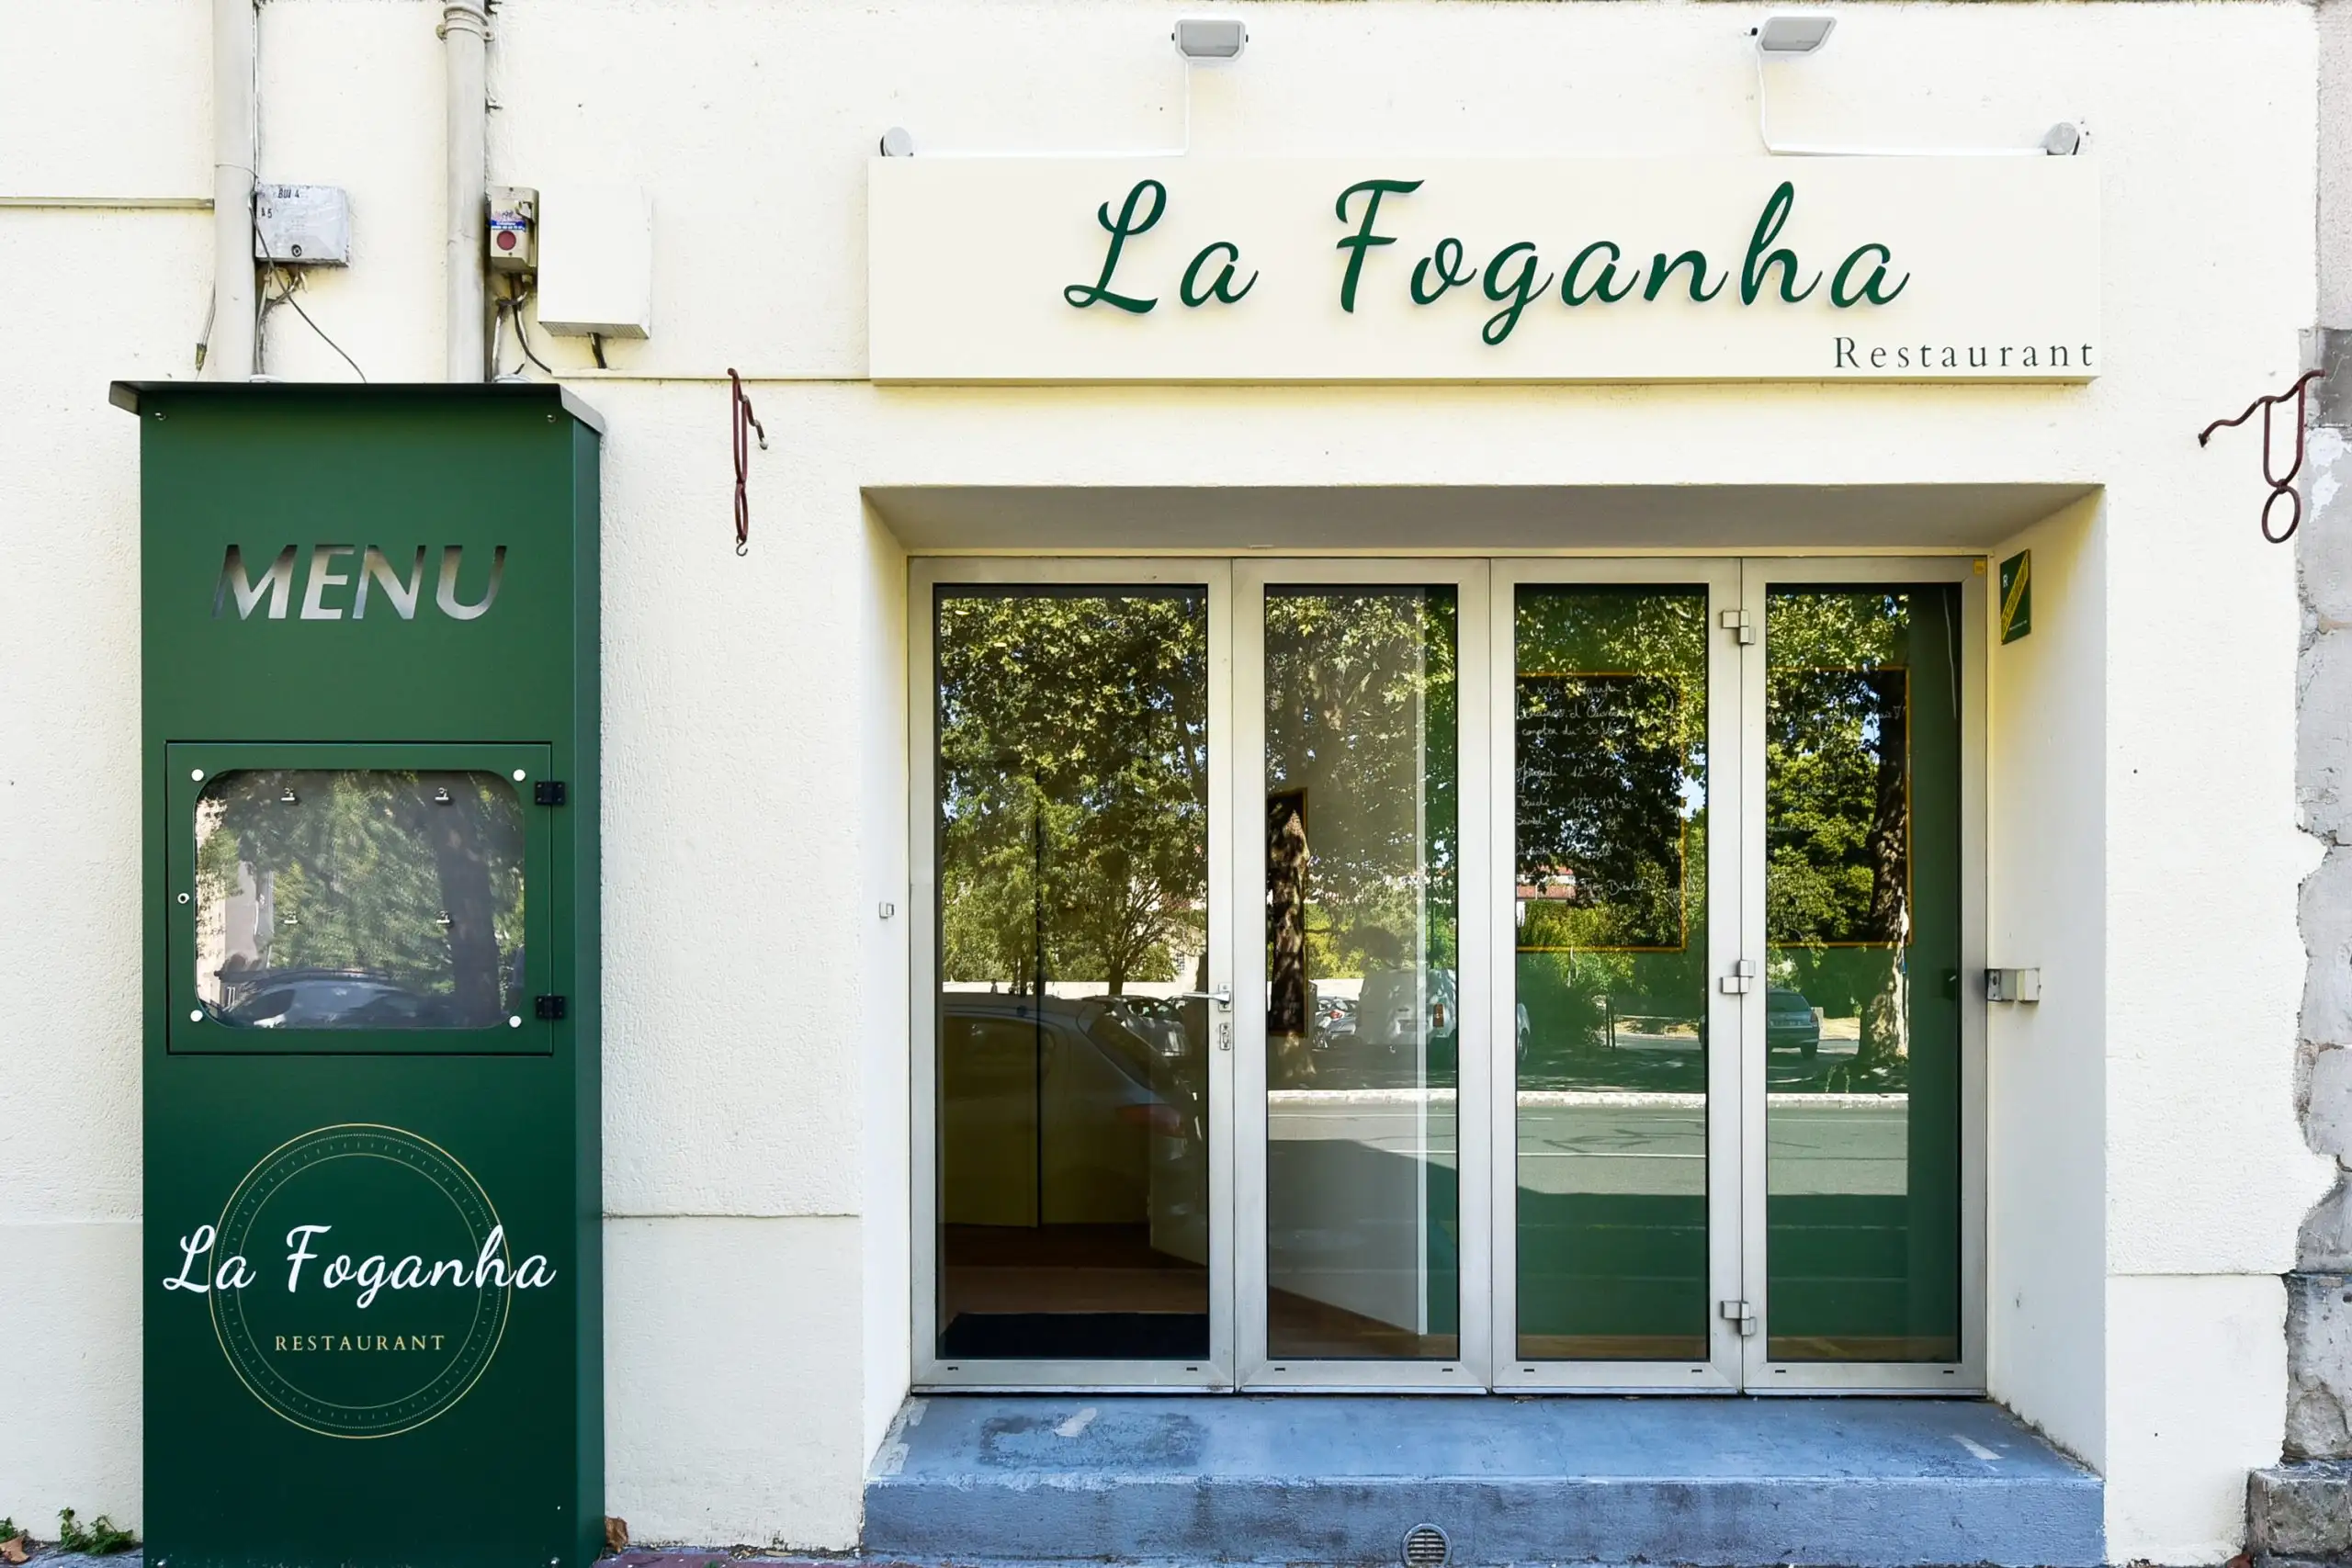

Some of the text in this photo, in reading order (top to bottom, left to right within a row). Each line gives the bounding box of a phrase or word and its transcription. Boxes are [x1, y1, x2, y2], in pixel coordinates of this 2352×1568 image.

[1064, 179, 1910, 345] La Foganha
[1836, 337, 2094, 368] Restaurant
[213, 544, 507, 620] MENU
[164, 1224, 557, 1309] La Foganha
[276, 1335, 446, 1351] RESTAURANT
